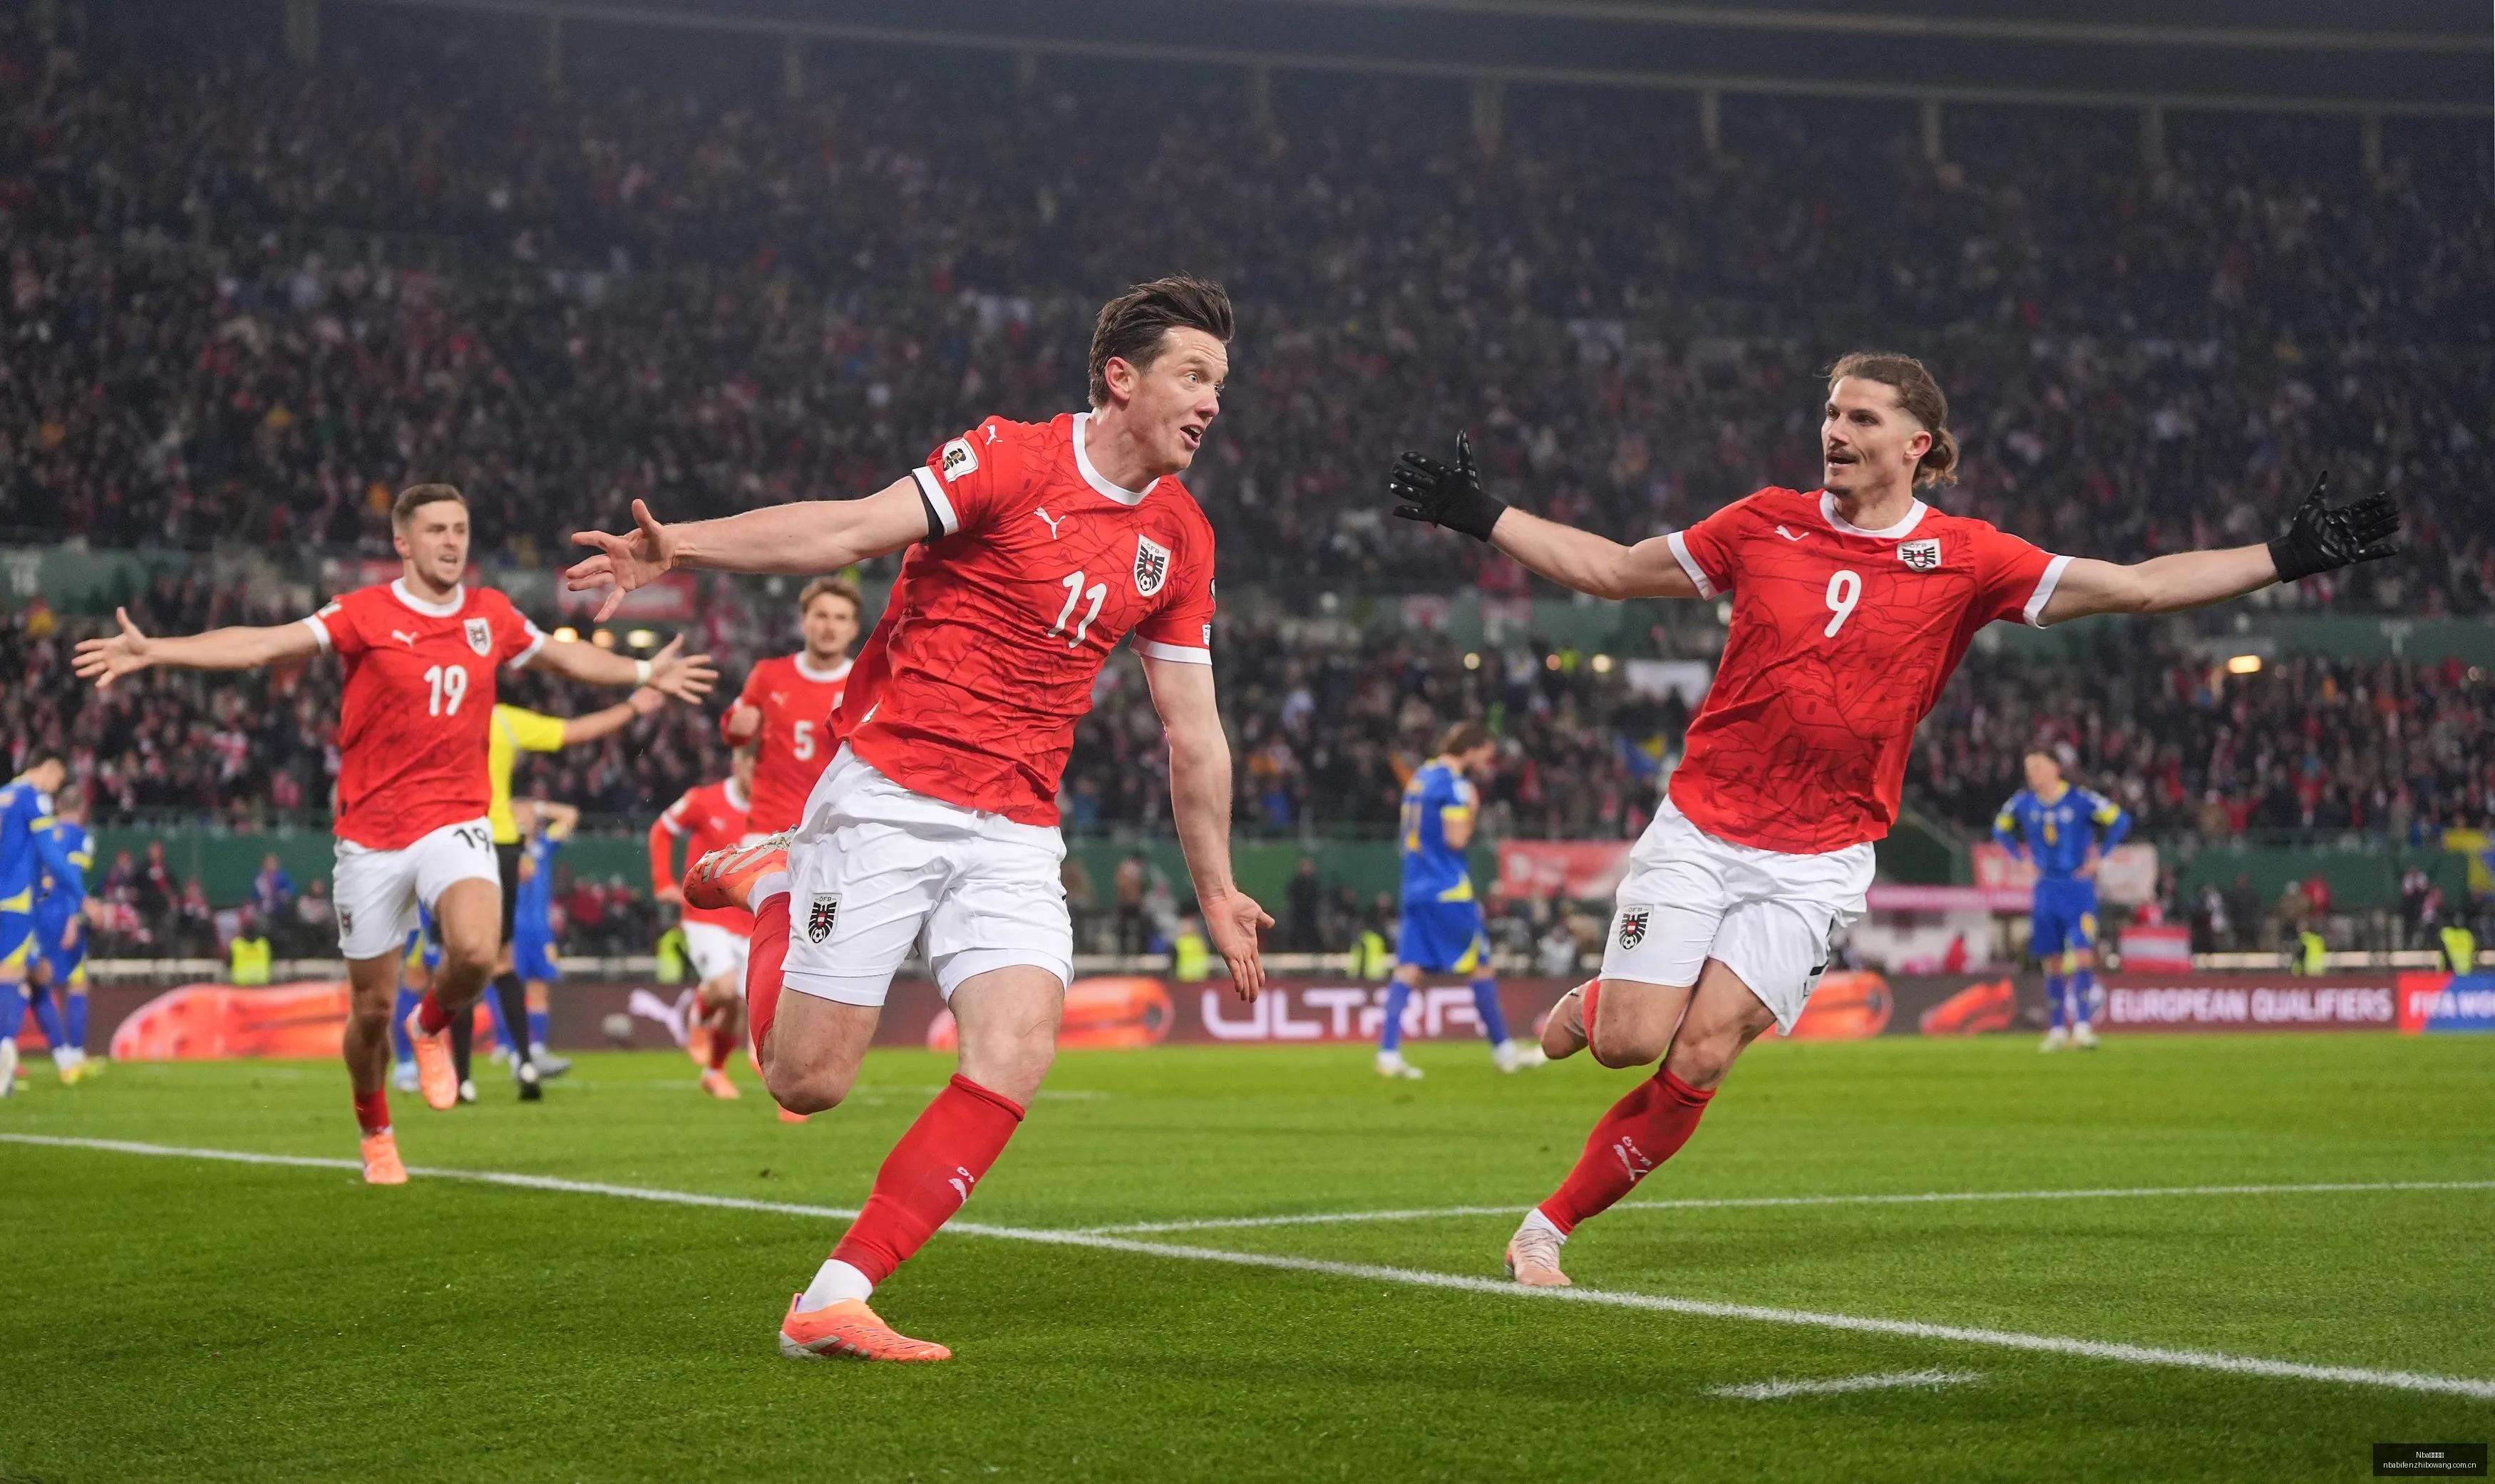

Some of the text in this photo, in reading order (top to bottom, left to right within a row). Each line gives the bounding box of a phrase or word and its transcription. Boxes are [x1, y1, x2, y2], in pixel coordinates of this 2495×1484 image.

[1047, 570, 1107, 649] 11
[1823, 569, 1862, 638] 9
[423, 664, 468, 716] 19
[793, 719, 815, 761] 5
[453, 827, 490, 852] 19
[2109, 987, 2394, 1022] EUROPEAN QUALIFIERS
[2409, 990, 2456, 1019] FIFA
